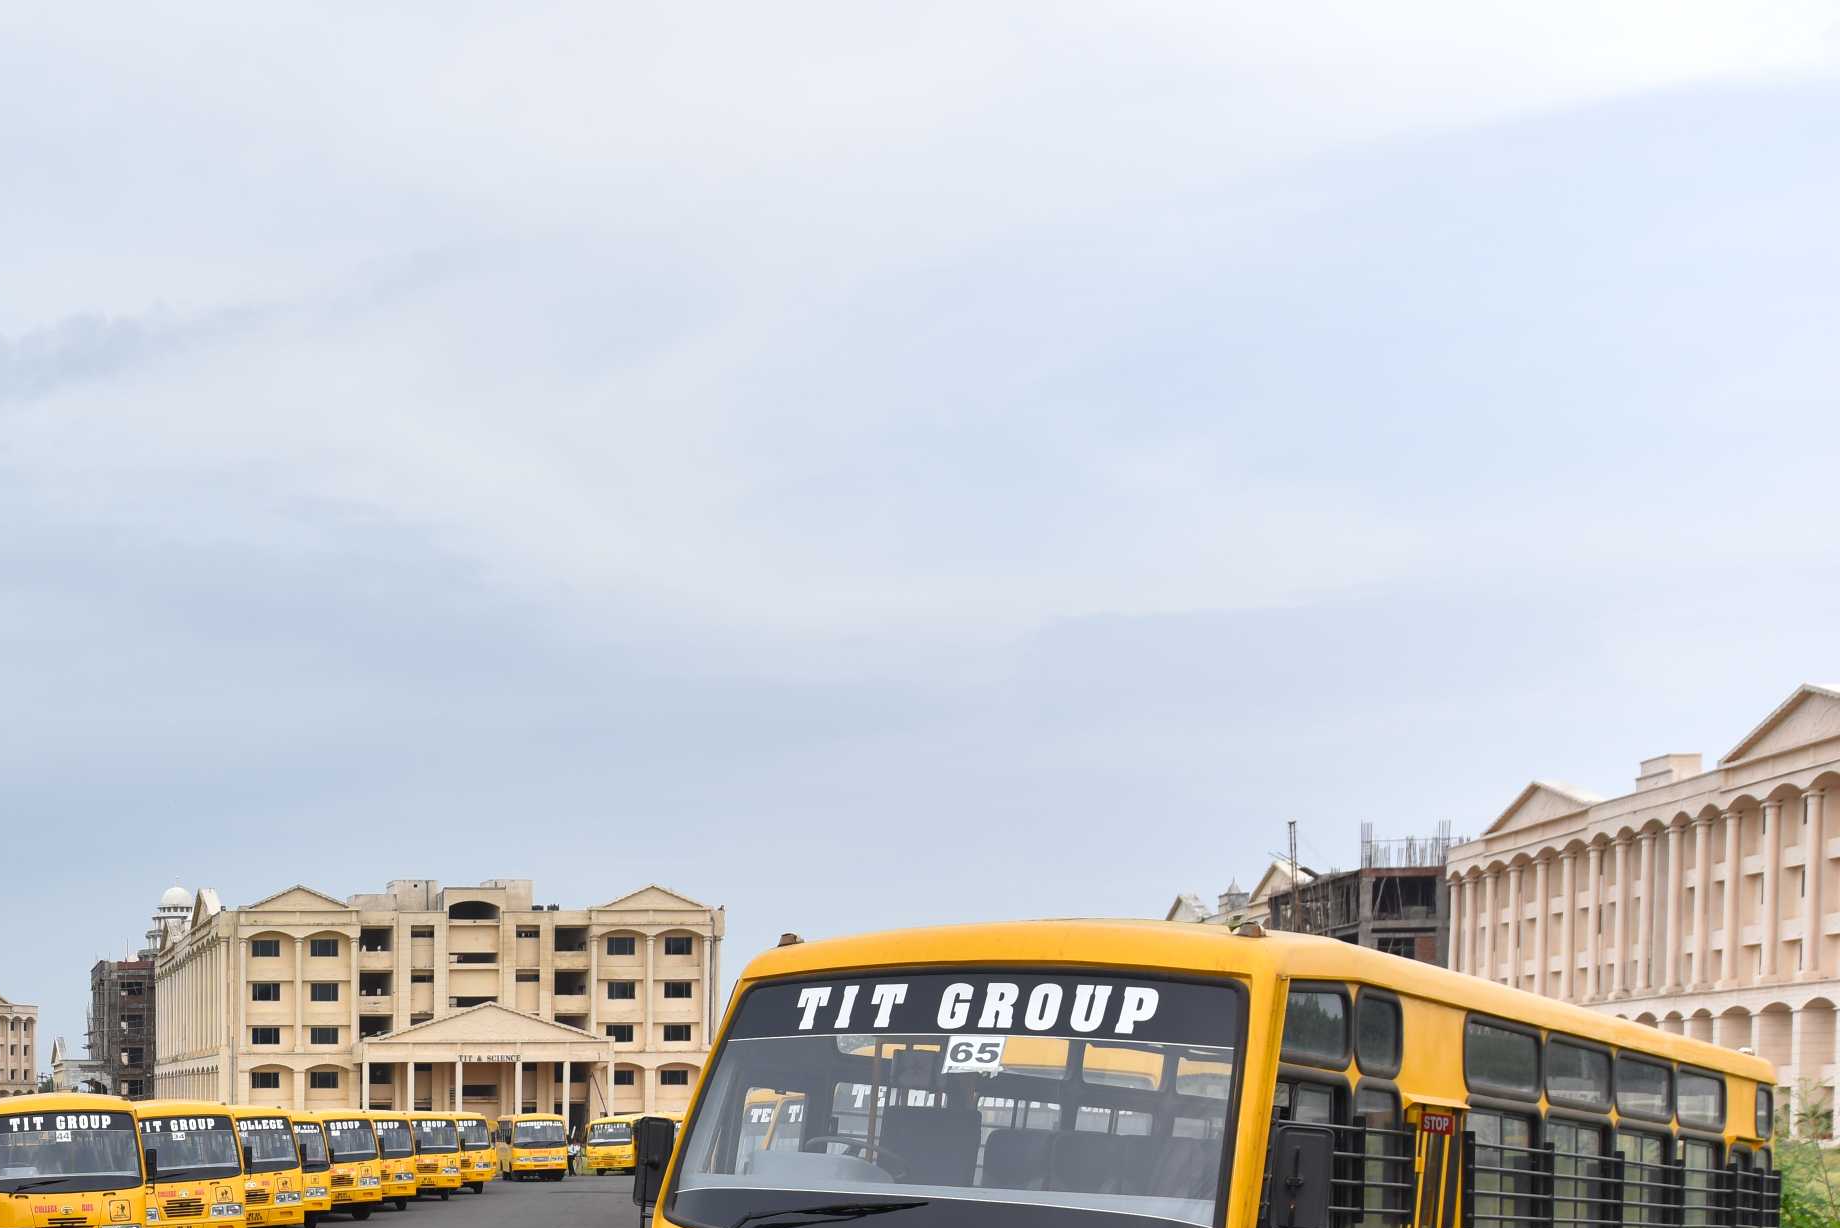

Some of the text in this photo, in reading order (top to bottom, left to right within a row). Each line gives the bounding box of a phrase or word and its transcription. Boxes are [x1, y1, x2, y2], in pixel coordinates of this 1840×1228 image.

[796, 982, 1160, 1034] TIT GROUP
[458, 1054, 474, 1062] TIT
[487, 1054, 521, 1062] SCIENCE
[949, 1041, 1001, 1065] 65
[9, 1115, 111, 1132] TIT GROUP
[170, 1118, 215, 1131] GROUP
[330, 1120, 360, 1130] GROUP
[422, 1120, 447, 1128] GROUP
[1423, 1115, 1449, 1131] STOP
[56, 1131, 70, 1141] 44
[34, 1205, 58, 1214] COLLEGE
